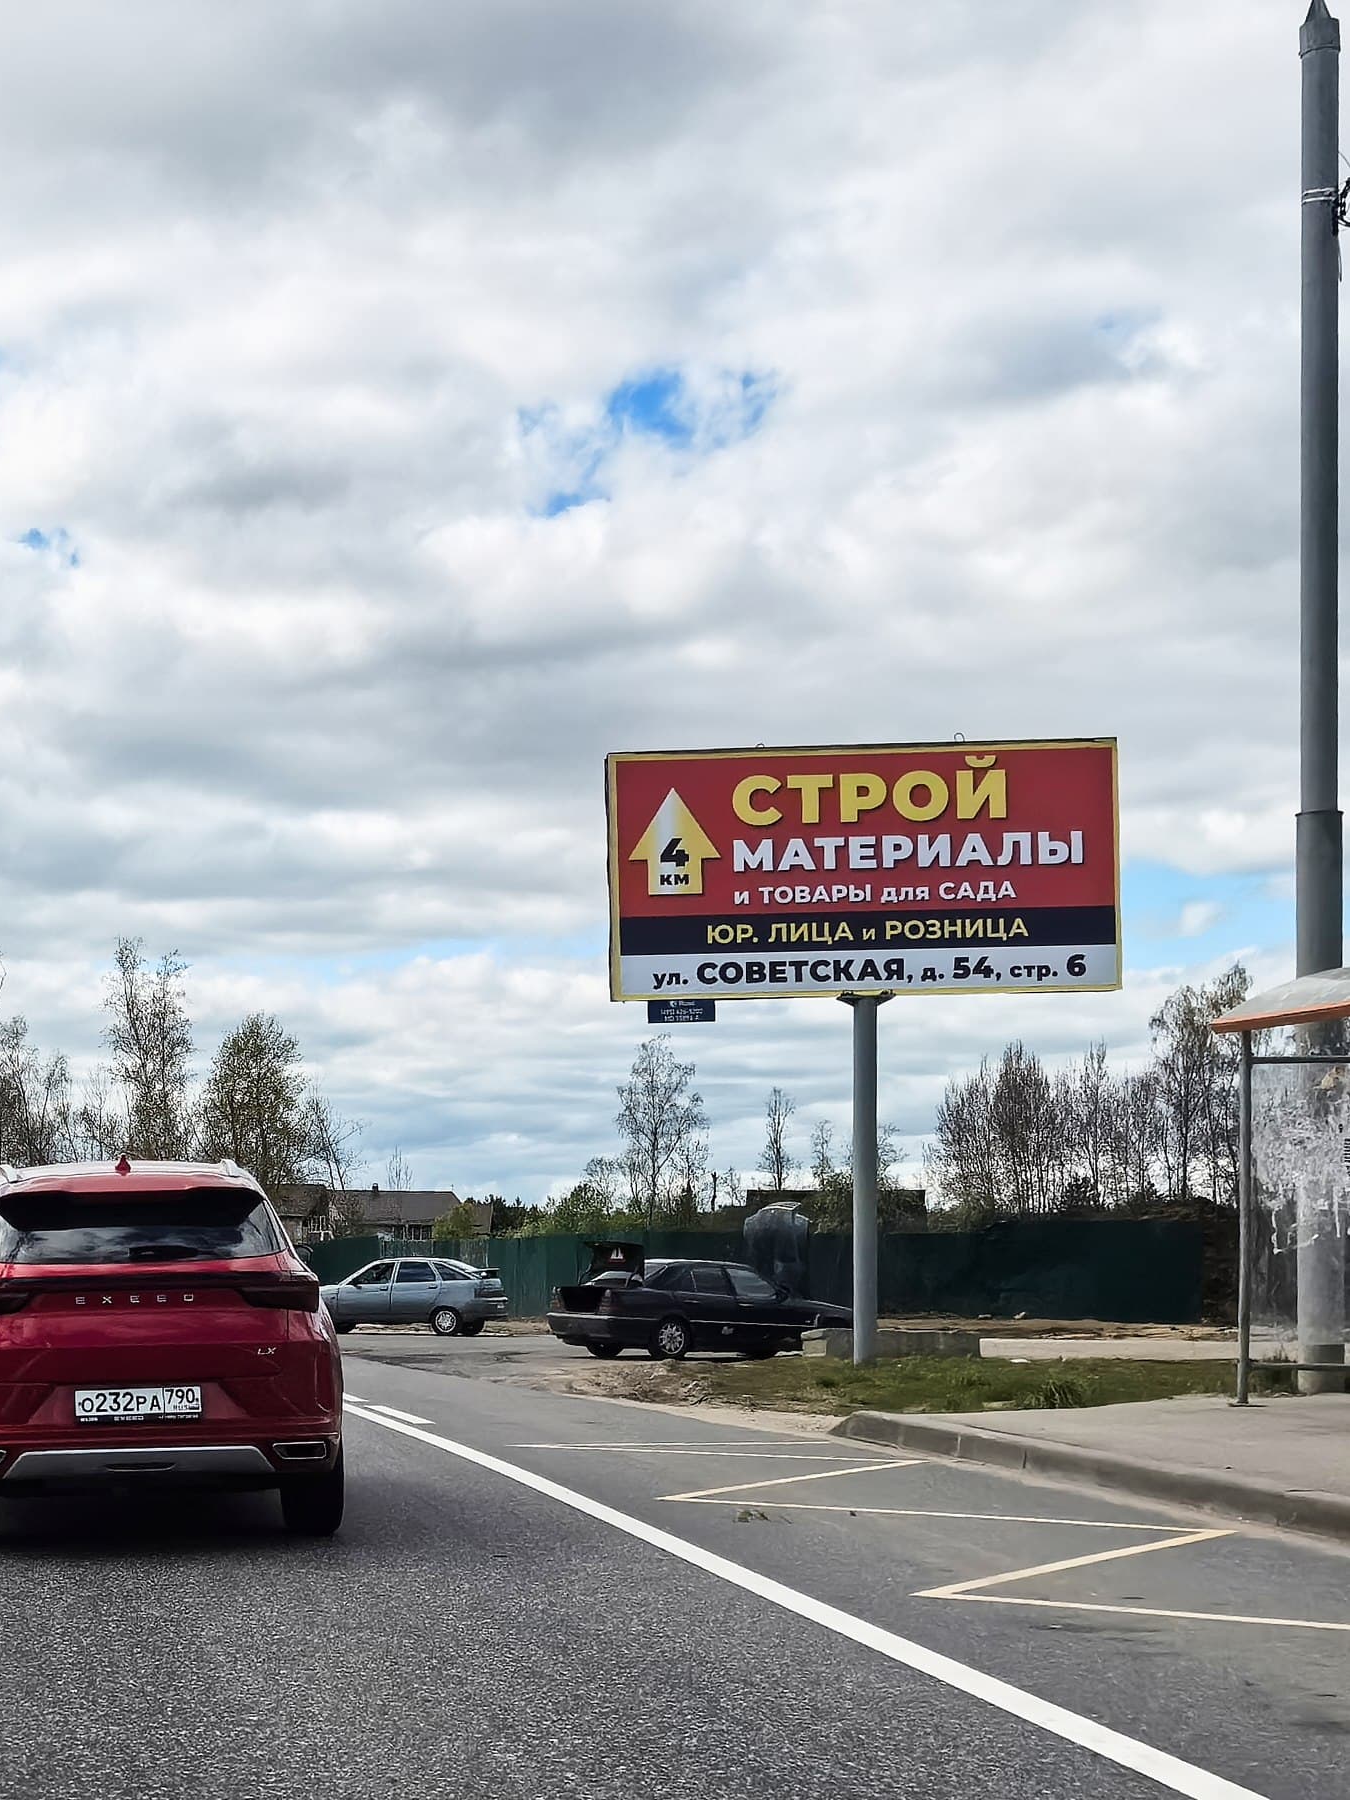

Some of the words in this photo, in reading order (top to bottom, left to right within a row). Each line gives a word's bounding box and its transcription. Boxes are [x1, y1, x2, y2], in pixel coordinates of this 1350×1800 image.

[732, 755, 1007, 826] СТРОЙ
[659, 837, 689, 868] 4
[732, 830, 1084, 873] МАТЕРИАЛЫ
[733, 890, 750, 906] и
[758, 882, 872, 904] ТОВАРЫ
[880, 885, 930, 904] для
[938, 880, 1017, 902] САДА
[706, 923, 759, 945] ЮР.
[767, 920, 854, 945] ЛИЦА
[862, 927, 876, 941] и
[884, 917, 1029, 941] РОЗНИЦА
[652, 971, 689, 990] ул.
[696, 957, 914, 984] СОВЕТСКАЯ,
[920, 965, 945, 983] д.
[952, 956, 1002, 981] 54,
[1009, 964, 1058, 981] стр.
[1066, 953, 1087, 977] 6
[75, 1294, 194, 1305] EXEED
[257, 1346, 277, 1355] LX
[81, 1391, 162, 1413] О232РА
[164, 1388, 196, 1404] 790
